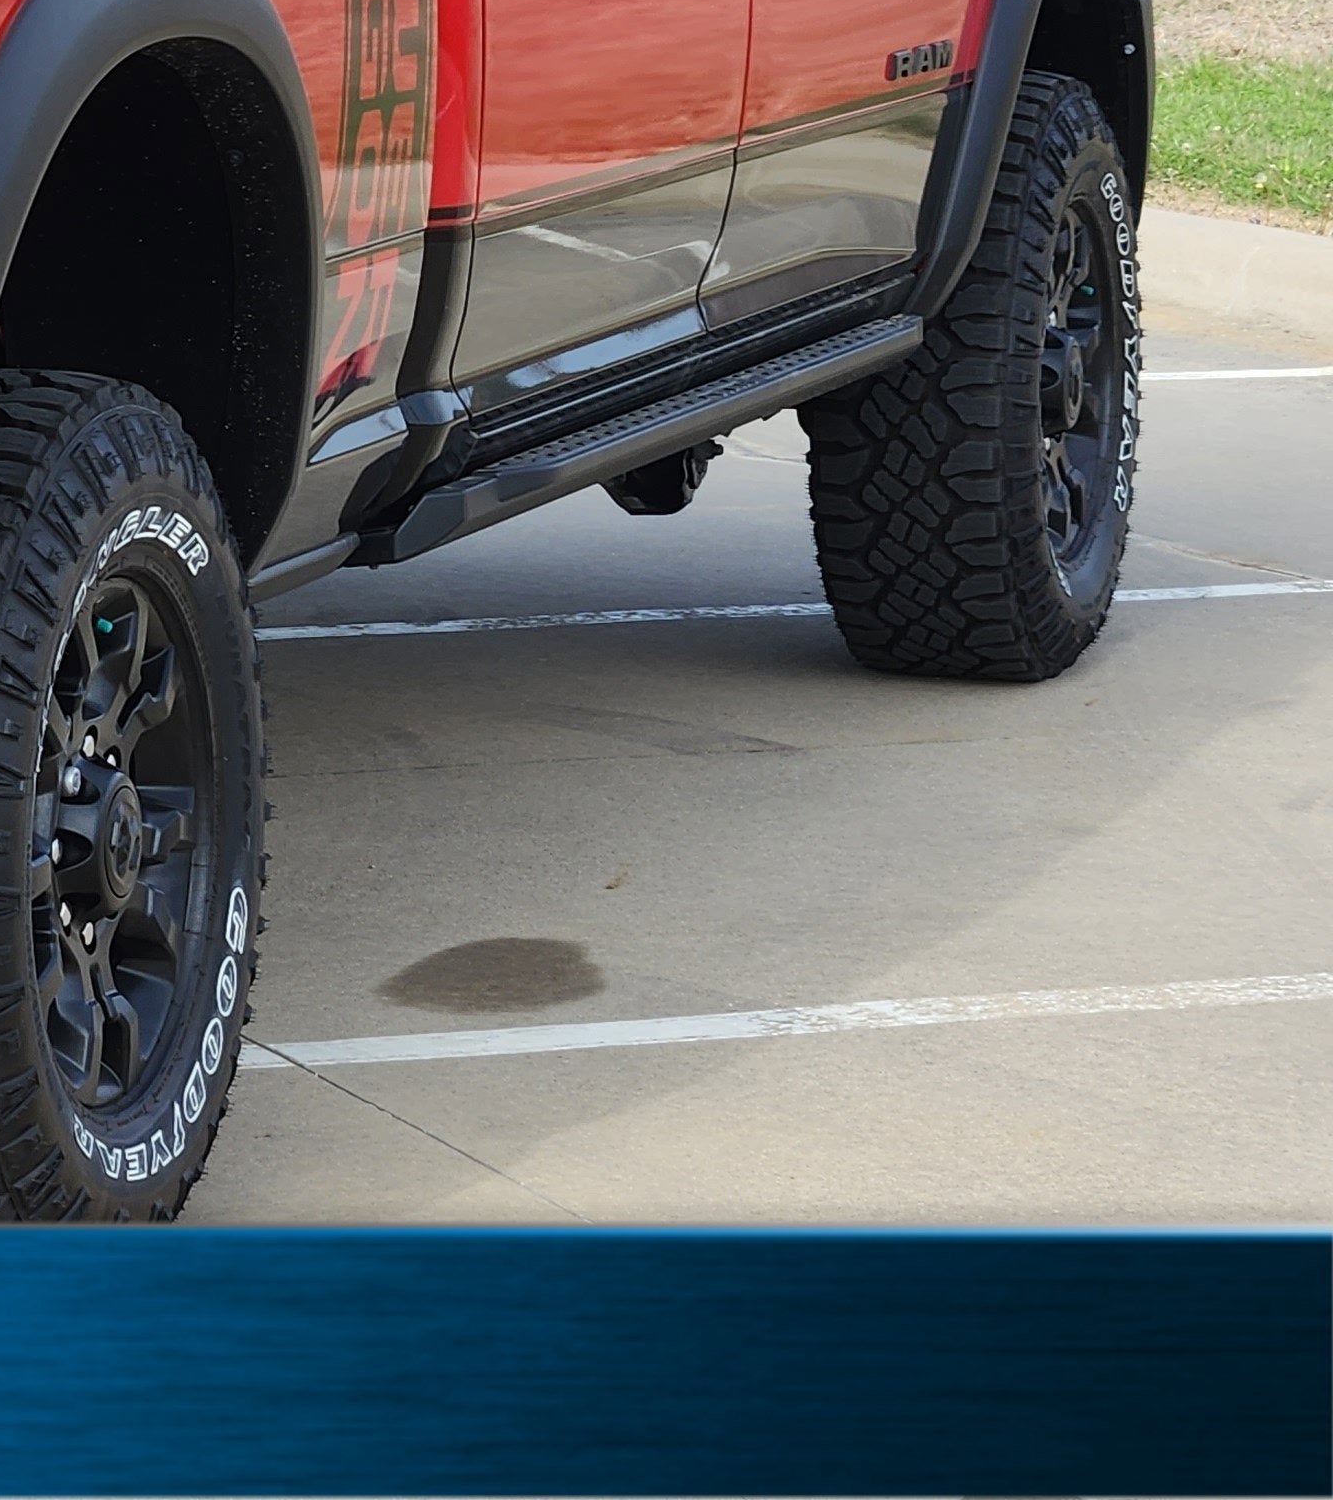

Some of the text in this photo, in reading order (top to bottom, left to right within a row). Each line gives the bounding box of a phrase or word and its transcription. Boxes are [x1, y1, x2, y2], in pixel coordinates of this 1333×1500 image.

[886, 39, 953, 80] RAM
[1099, 171, 1140, 513] GOODYEAR
[73, 886, 248, 1182] GOODYEAR
